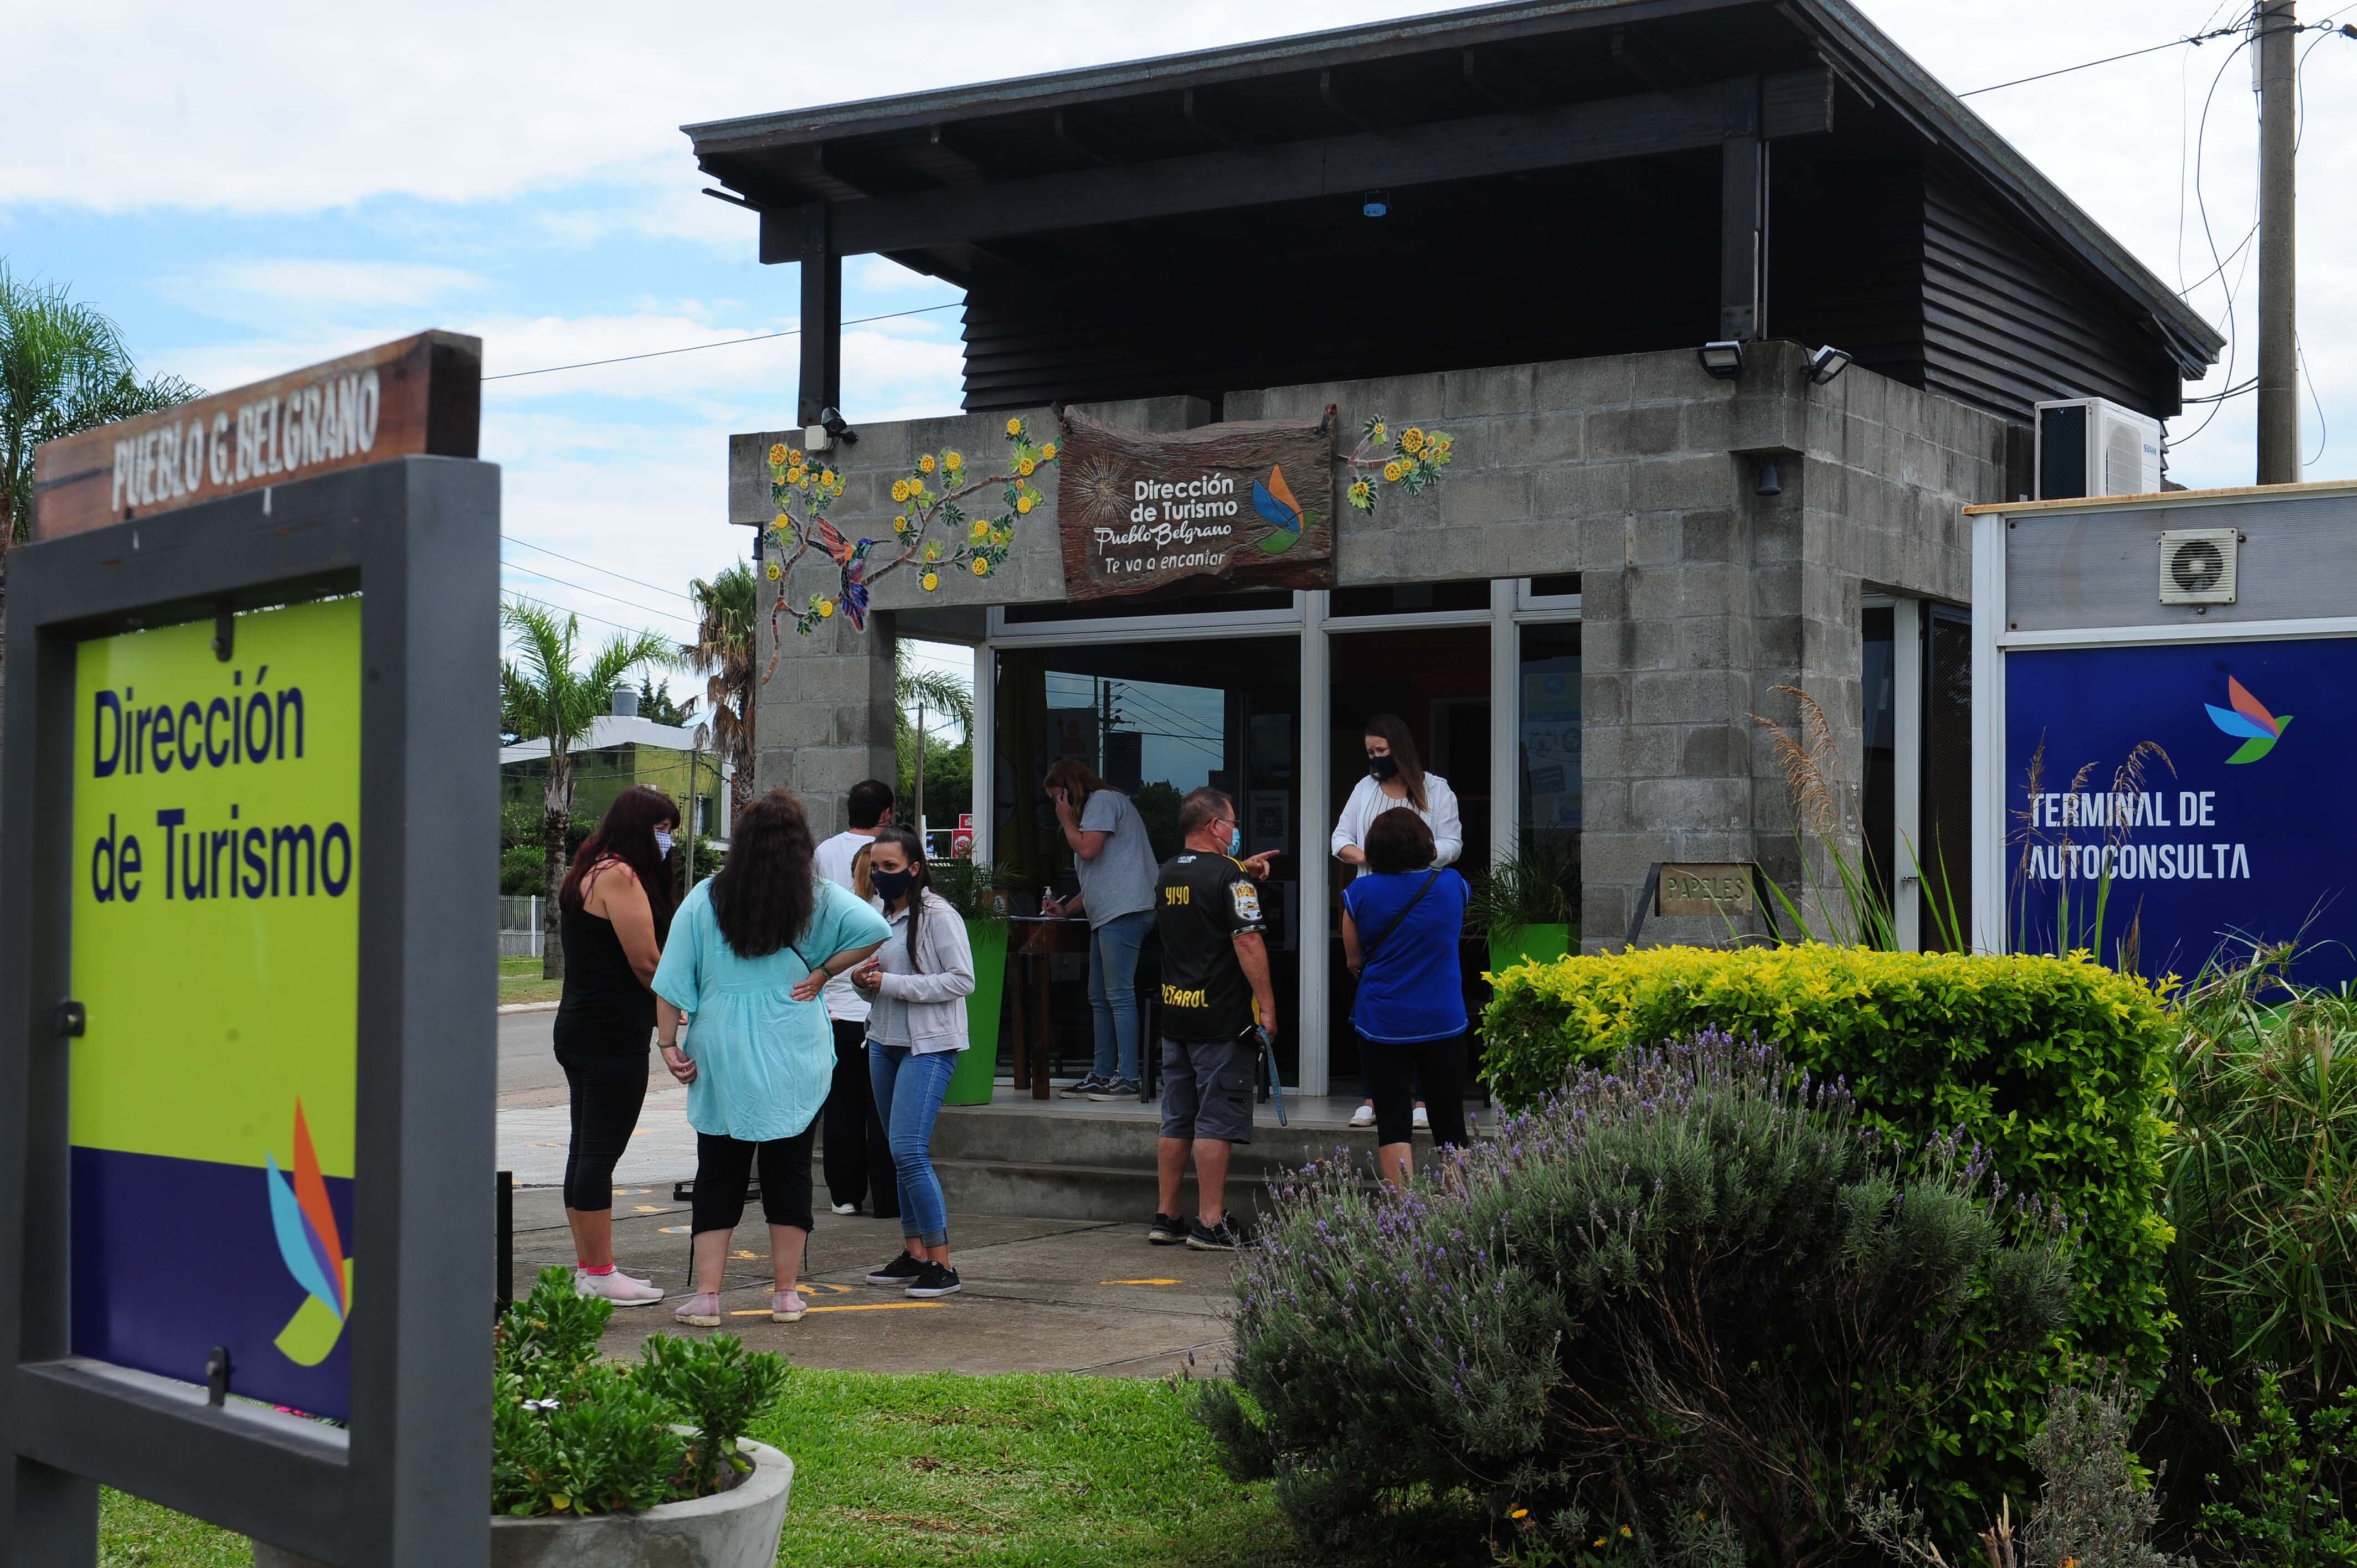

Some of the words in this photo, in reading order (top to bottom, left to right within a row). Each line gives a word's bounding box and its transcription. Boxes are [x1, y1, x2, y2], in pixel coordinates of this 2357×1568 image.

[111, 417, 204, 512] PUEBLO
[1135, 472, 1234, 501] Dirección
[1130, 503, 1157, 523] de
[1162, 499, 1238, 520] Turismo
[1094, 524, 1152, 555] Pueblo
[1150, 520, 1232, 551] Belgrano
[1105, 558, 1120, 573] Te
[1125, 559, 1142, 572] va
[1147, 558, 1155, 569] a
[1161, 549, 1226, 569] encantar
[93, 666, 304, 778] Dirección
[2027, 792, 2171, 827] TERMINAL
[2179, 791, 2216, 827] DE
[91, 813, 142, 904] de
[157, 804, 352, 901] Turismo
[2028, 843, 2250, 880] AUTOCONSULTA
[1165, 885, 1190, 905] YIYO
[1668, 877, 1744, 901] PAPELES
